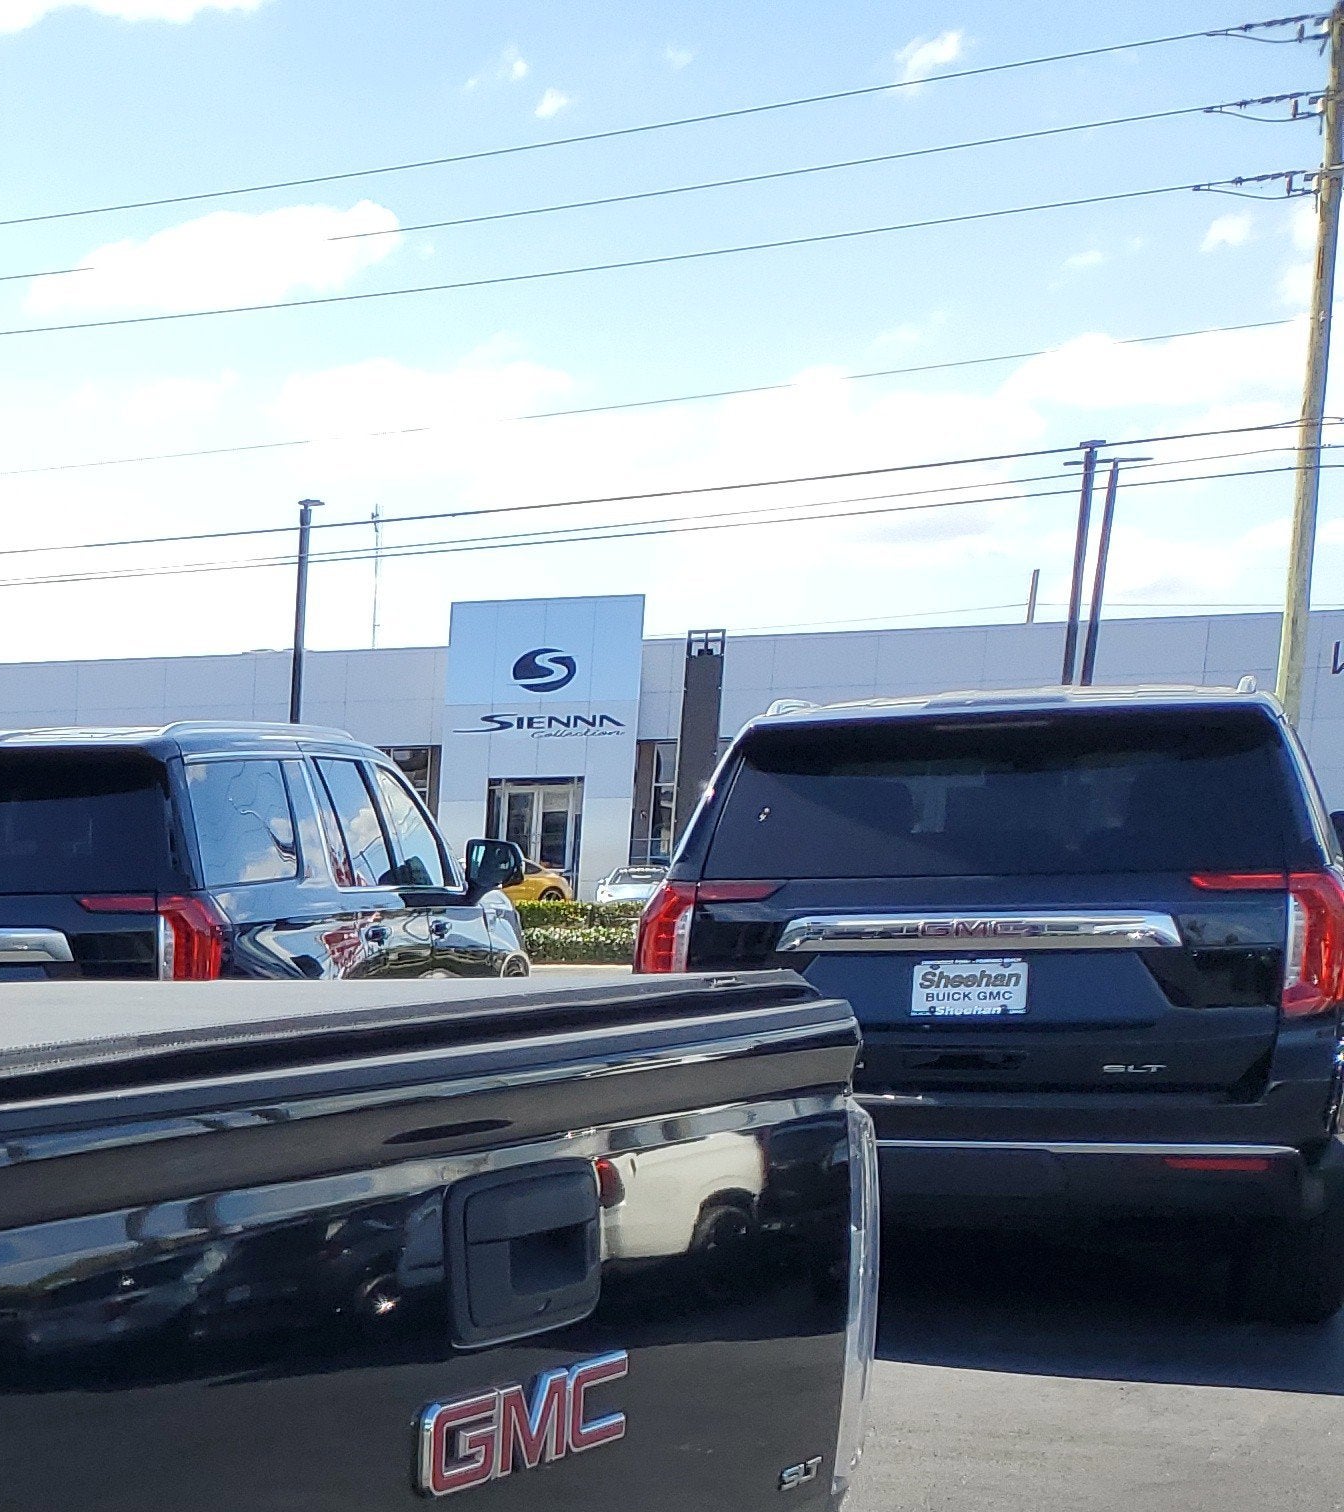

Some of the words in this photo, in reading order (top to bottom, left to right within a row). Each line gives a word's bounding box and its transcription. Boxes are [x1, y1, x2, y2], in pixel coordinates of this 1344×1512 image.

[453, 713, 626, 734] SIENNA
[531, 729, 625, 740] Collection
[917, 919, 1026, 938] GMC
[918, 969, 1022, 990] Sheehan
[925, 991, 973, 1002] BUICK
[976, 990, 1013, 1001] GMC
[1102, 1064, 1168, 1073] SLT
[420, 1350, 628, 1496] GMC
[780, 1455, 823, 1492] SLT
